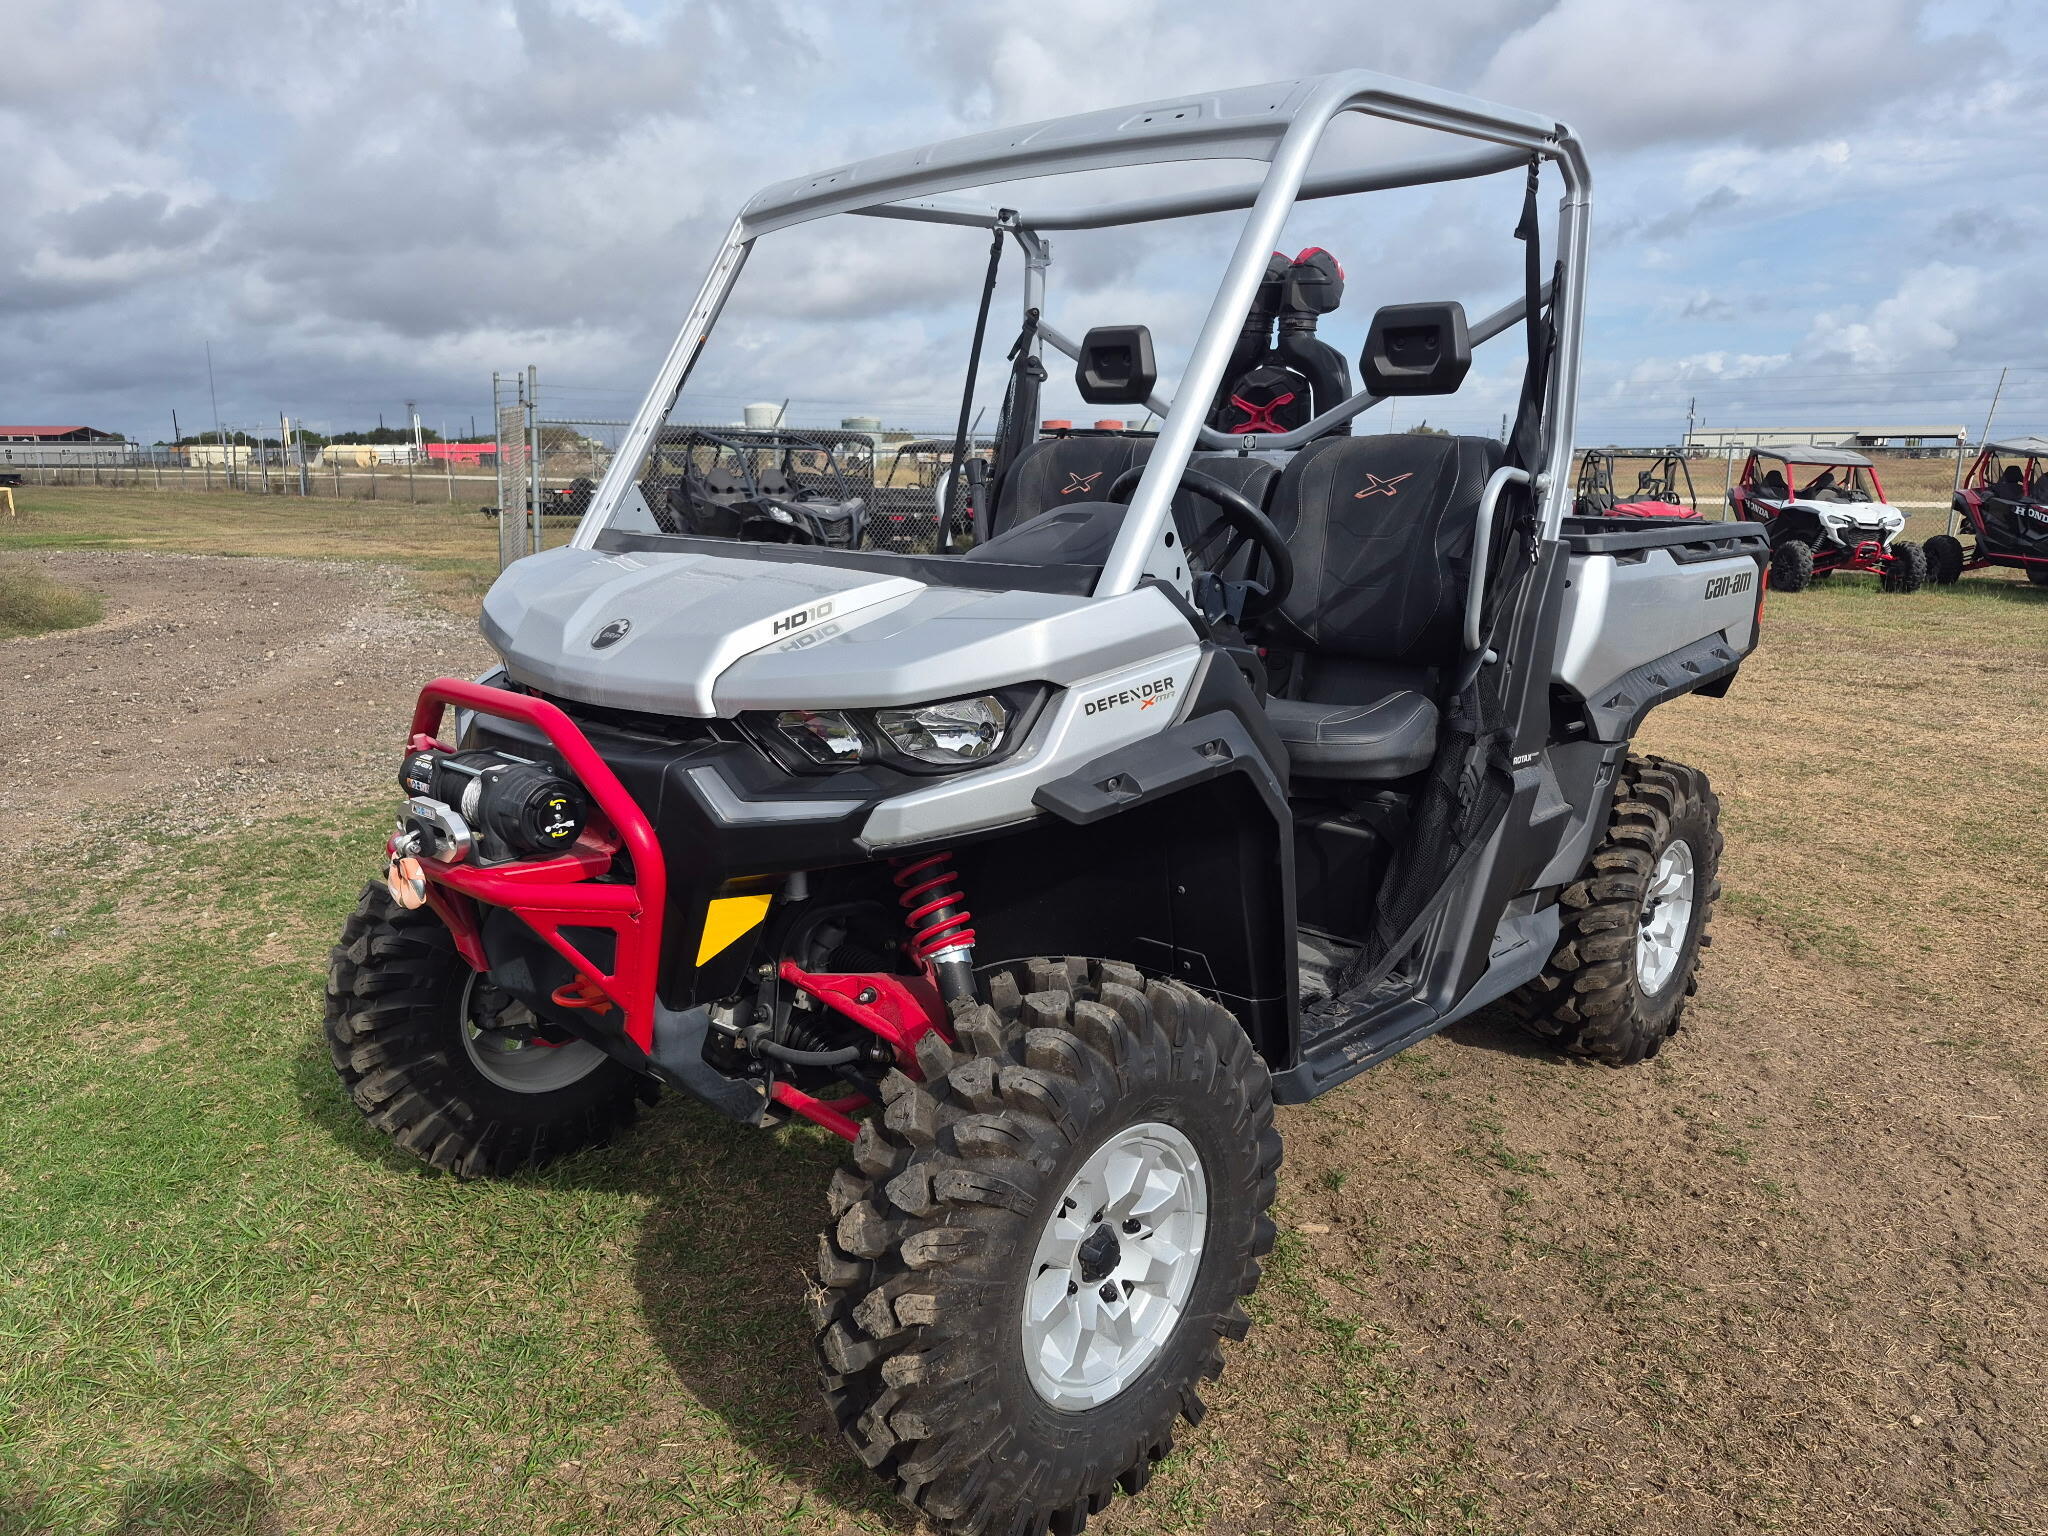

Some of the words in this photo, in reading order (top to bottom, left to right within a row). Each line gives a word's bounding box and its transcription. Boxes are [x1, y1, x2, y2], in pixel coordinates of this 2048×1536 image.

[774, 602, 832, 635] HD10
[1084, 677, 1174, 716] DEFENDER
[1512, 754, 1532, 765] ROTAX
